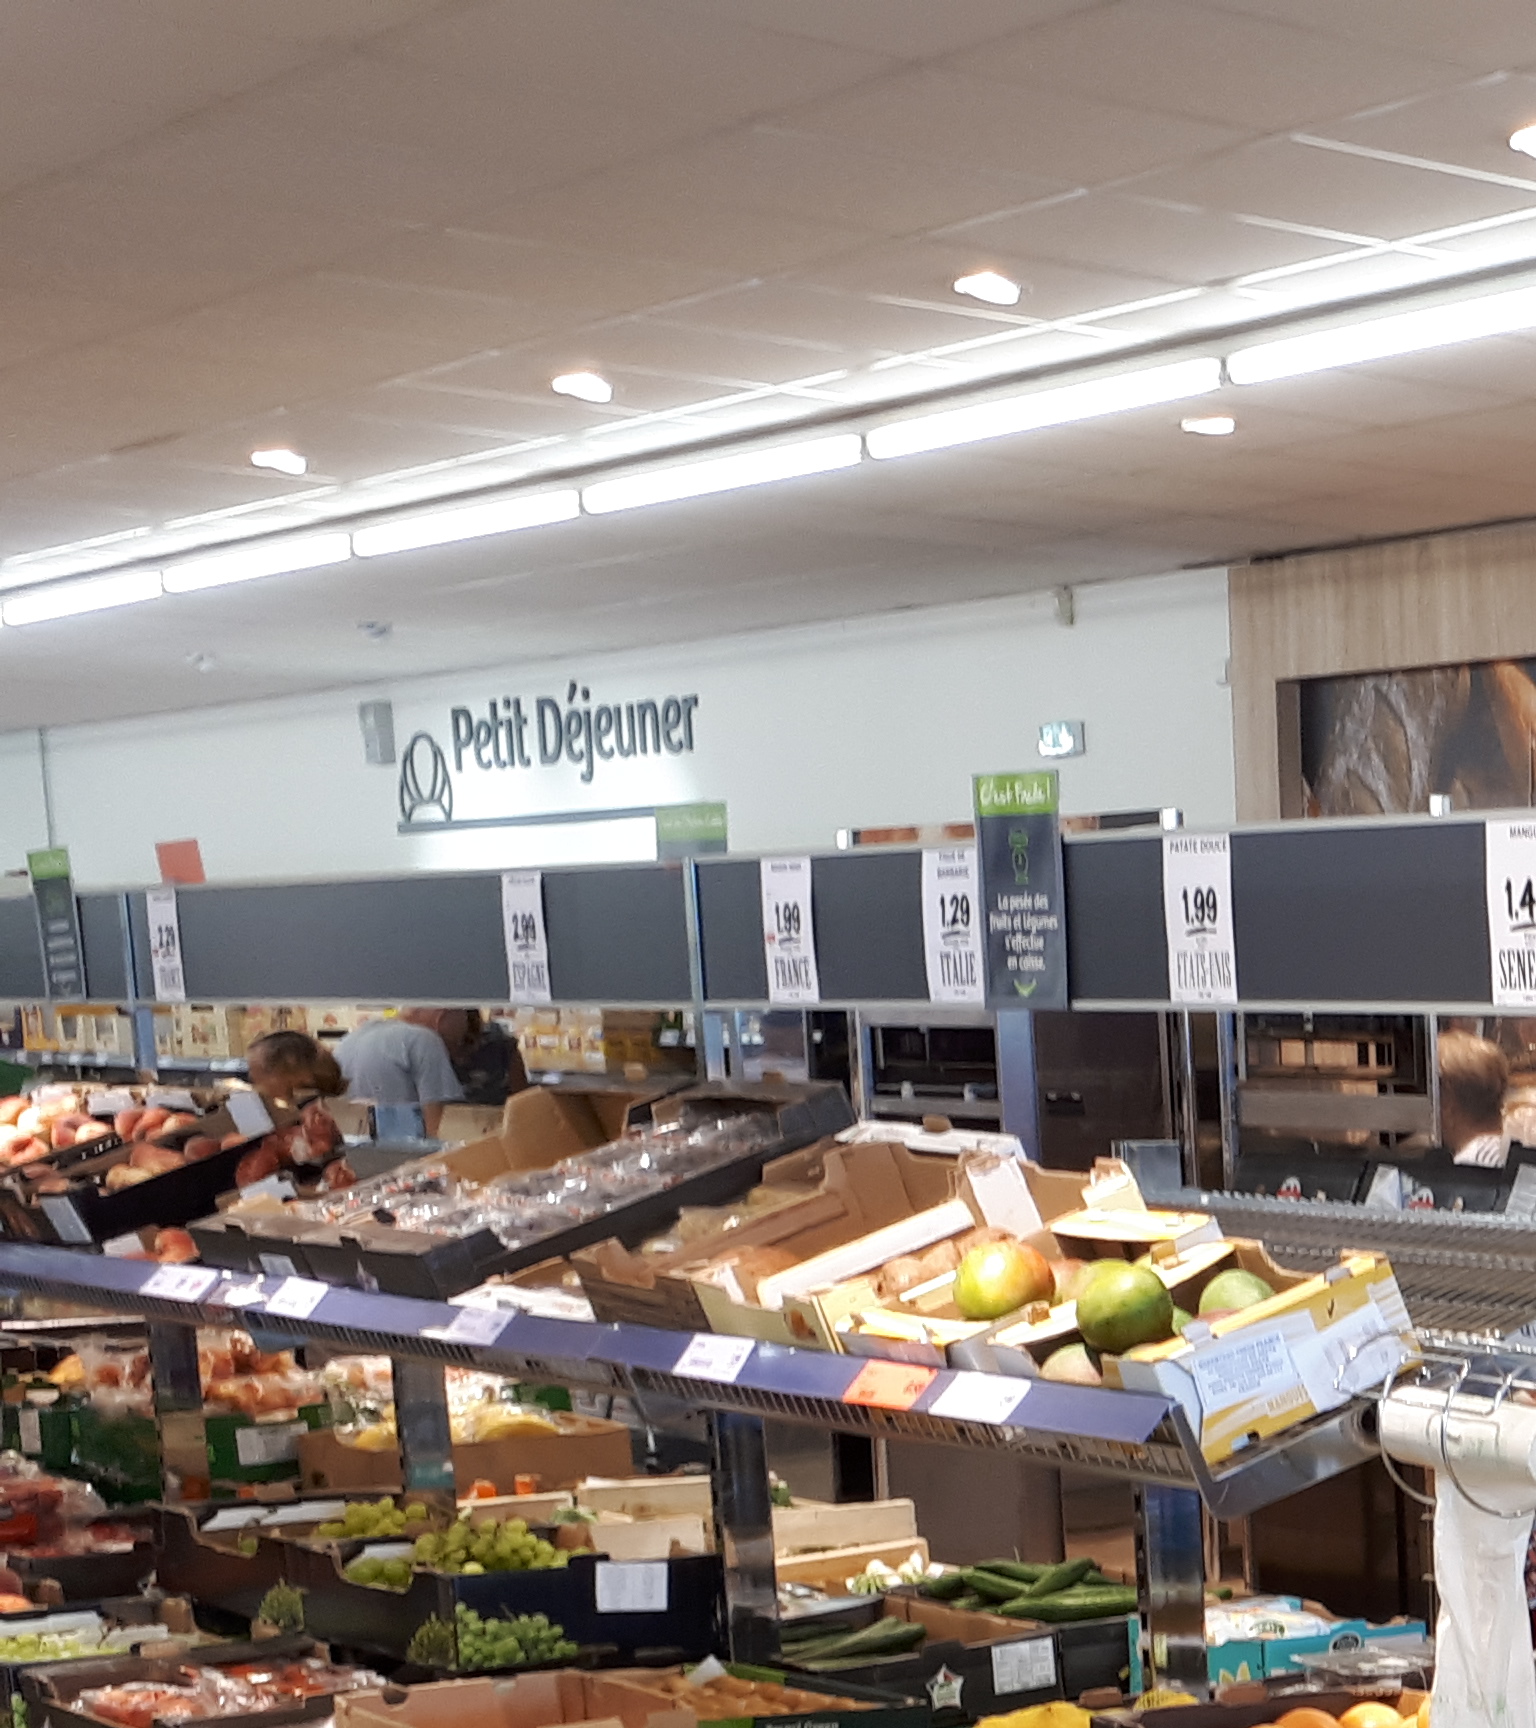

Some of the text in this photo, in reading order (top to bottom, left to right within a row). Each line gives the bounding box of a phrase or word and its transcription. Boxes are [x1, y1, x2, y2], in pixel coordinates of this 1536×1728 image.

[451, 681, 699, 783] Petit Déjeuner
[1169, 839, 1198, 855] PATATE
[940, 893, 970, 928] 1.29
[1182, 885, 1217, 926] 1.99
[774, 956, 811, 990] FRANCE
[940, 952, 977, 988] ITALIE
